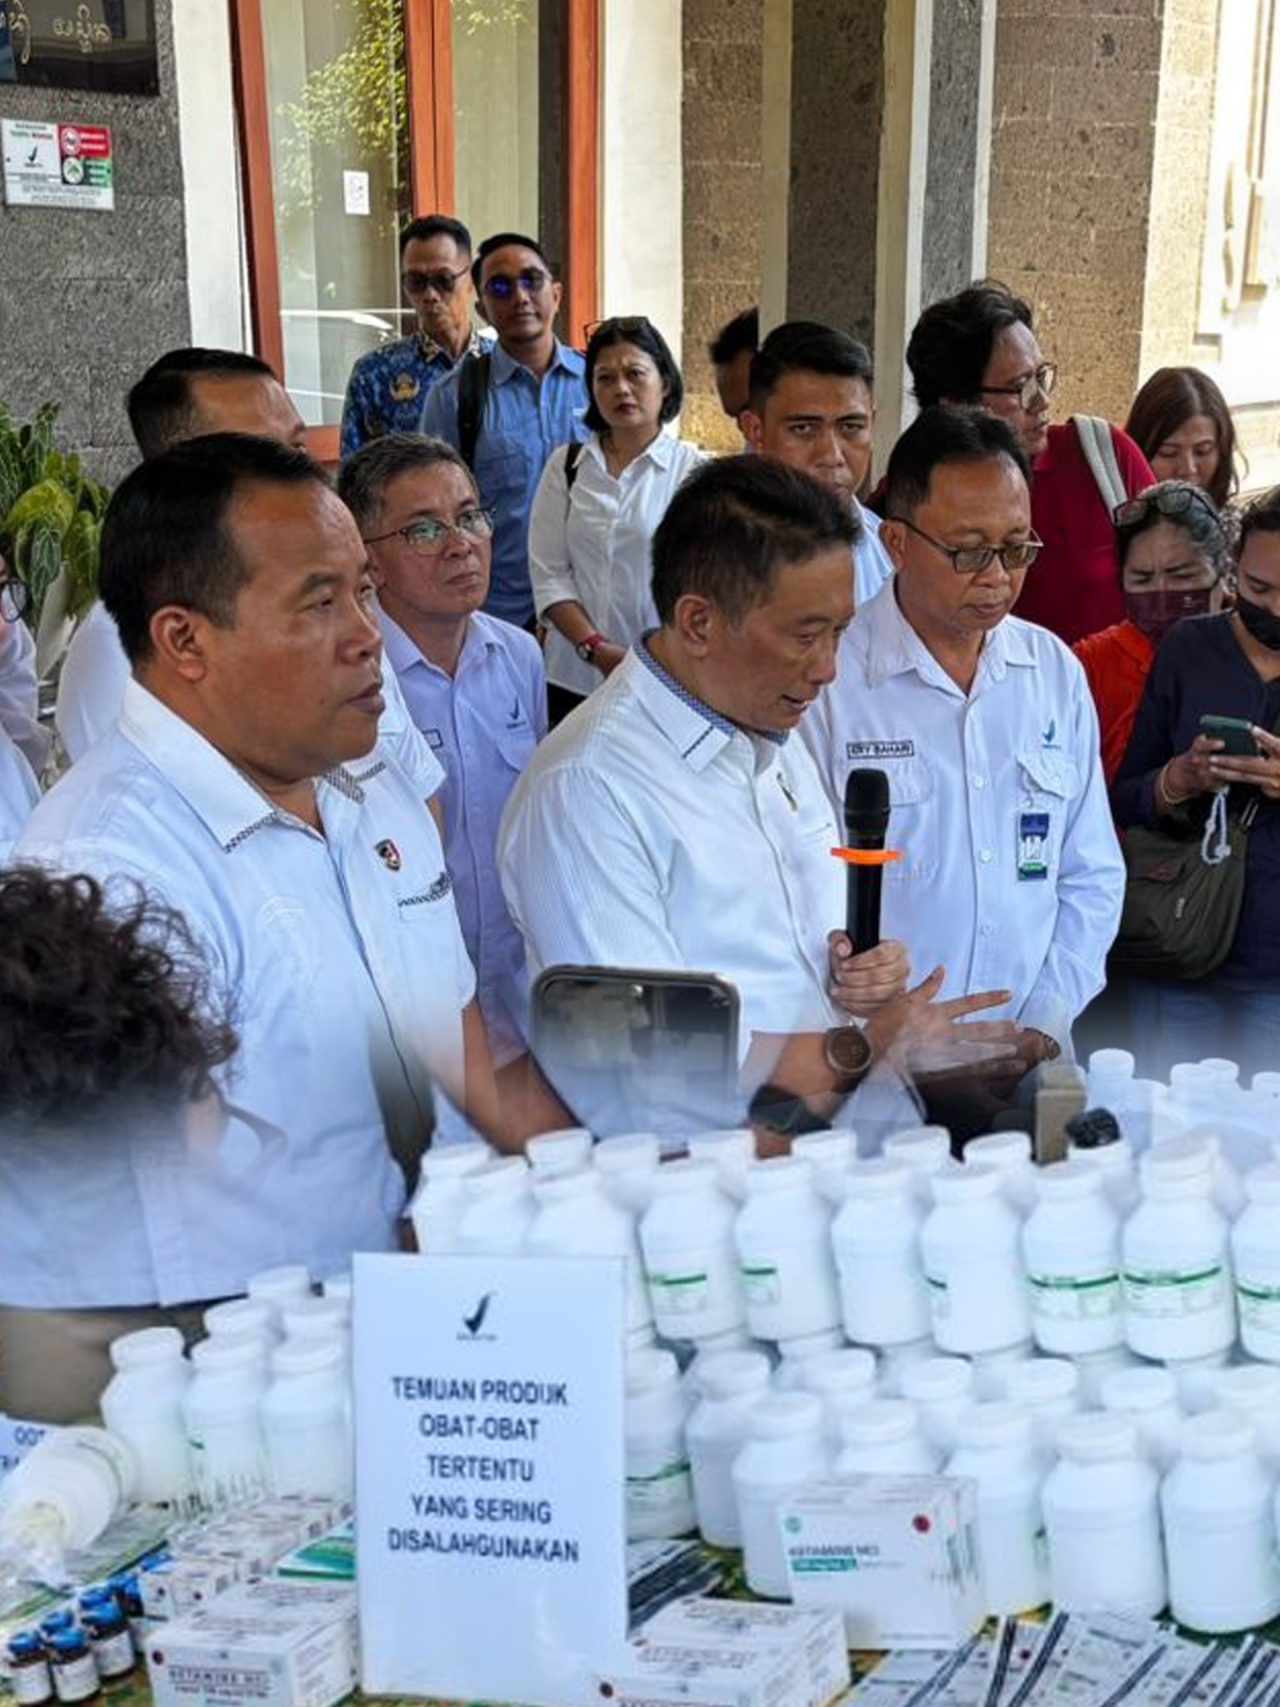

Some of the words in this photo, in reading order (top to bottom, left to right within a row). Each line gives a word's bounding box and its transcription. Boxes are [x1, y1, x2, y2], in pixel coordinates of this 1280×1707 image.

[391, 1375, 477, 1400] TEMUAN
[480, 1379, 568, 1405] PRODUK
[419, 1412, 540, 1441] OBAT-OBAT
[426, 1454, 535, 1482] TERTENTU
[411, 1494, 468, 1520] YANG
[473, 1497, 553, 1526] SERING
[387, 1527, 580, 1564] DISALAHGUNAKAN
